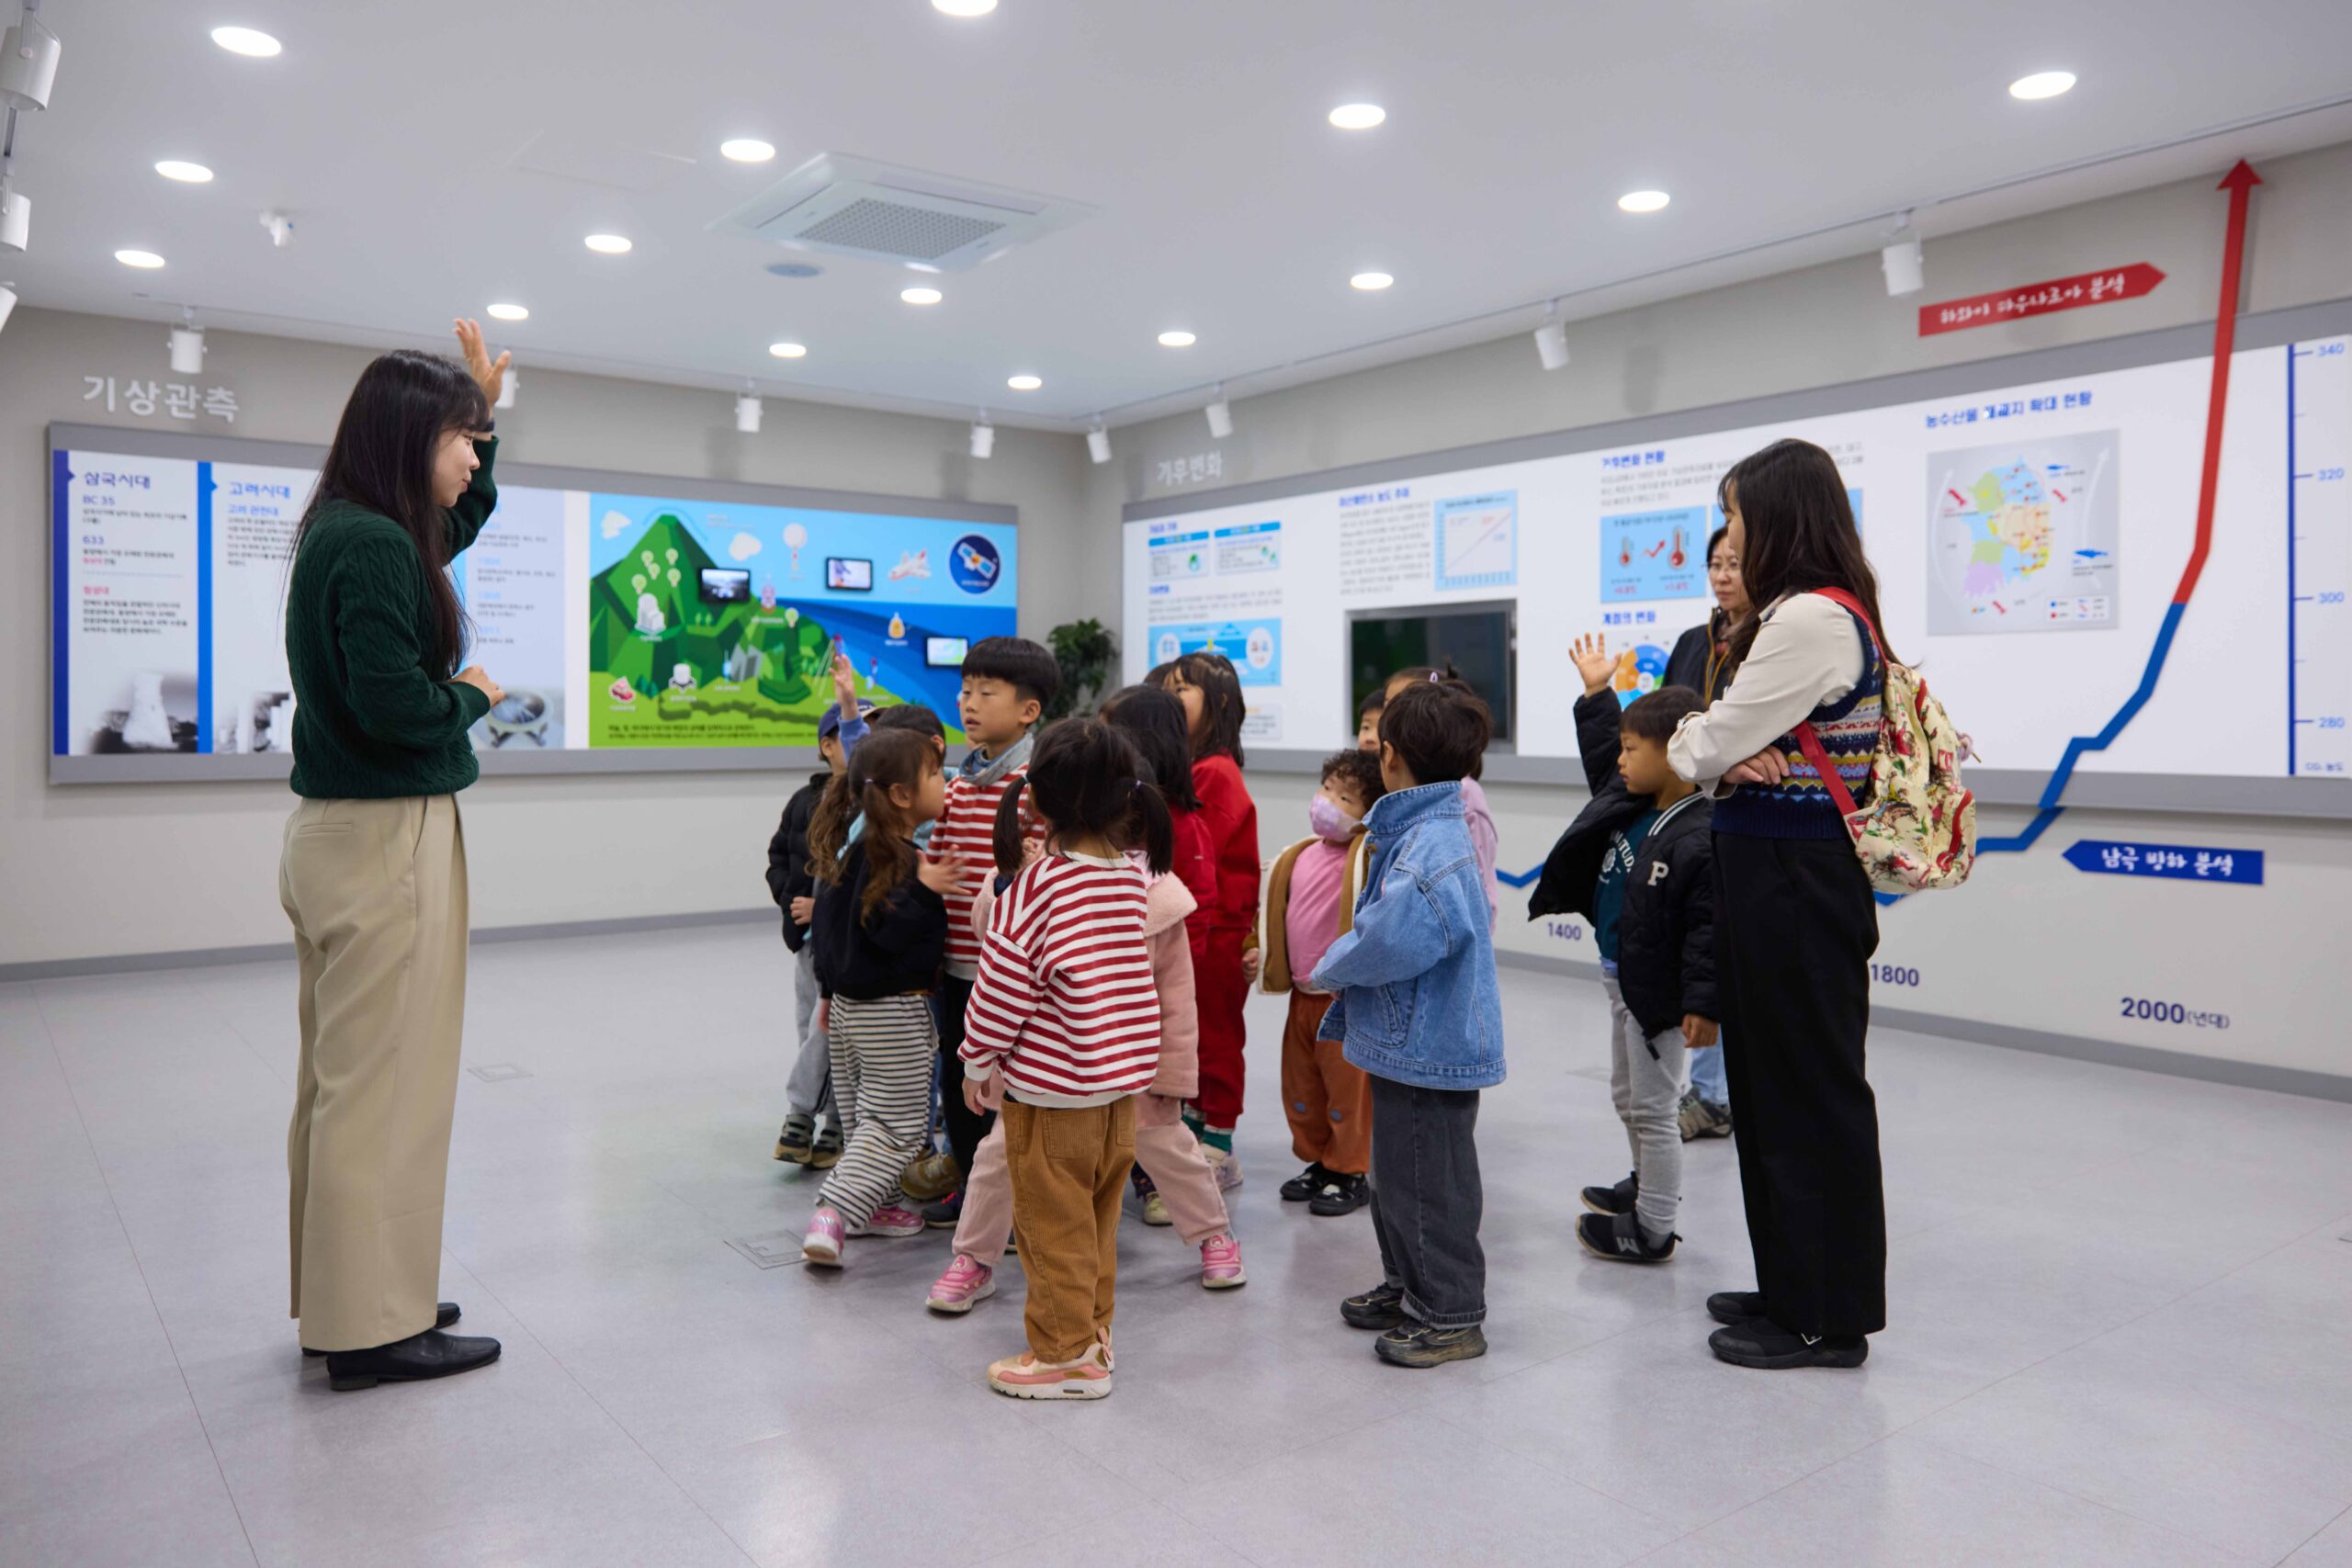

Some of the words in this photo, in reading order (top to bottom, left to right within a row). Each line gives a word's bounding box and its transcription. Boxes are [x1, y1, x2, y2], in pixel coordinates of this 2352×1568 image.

[1940, 301, 1991, 325] 하와이
[2088, 273, 2126, 301] 분석
[2318, 343, 2345, 357] 340
[83, 375, 239, 423] 기상관측
[85, 471, 151, 490] 삼국시대
[2318, 468, 2345, 482] 320
[229, 480, 291, 500] 고려시대
[83, 535, 105, 546] 633
[2318, 591, 2345, 604] 300
[2319, 716, 2346, 729] 280
[2101, 845, 2140, 872] 남극
[2194, 851, 2233, 877] 분석
[1647, 860, 1669, 886] P
[1547, 921, 1582, 942] 1400
[1871, 963, 1921, 987] 1800
